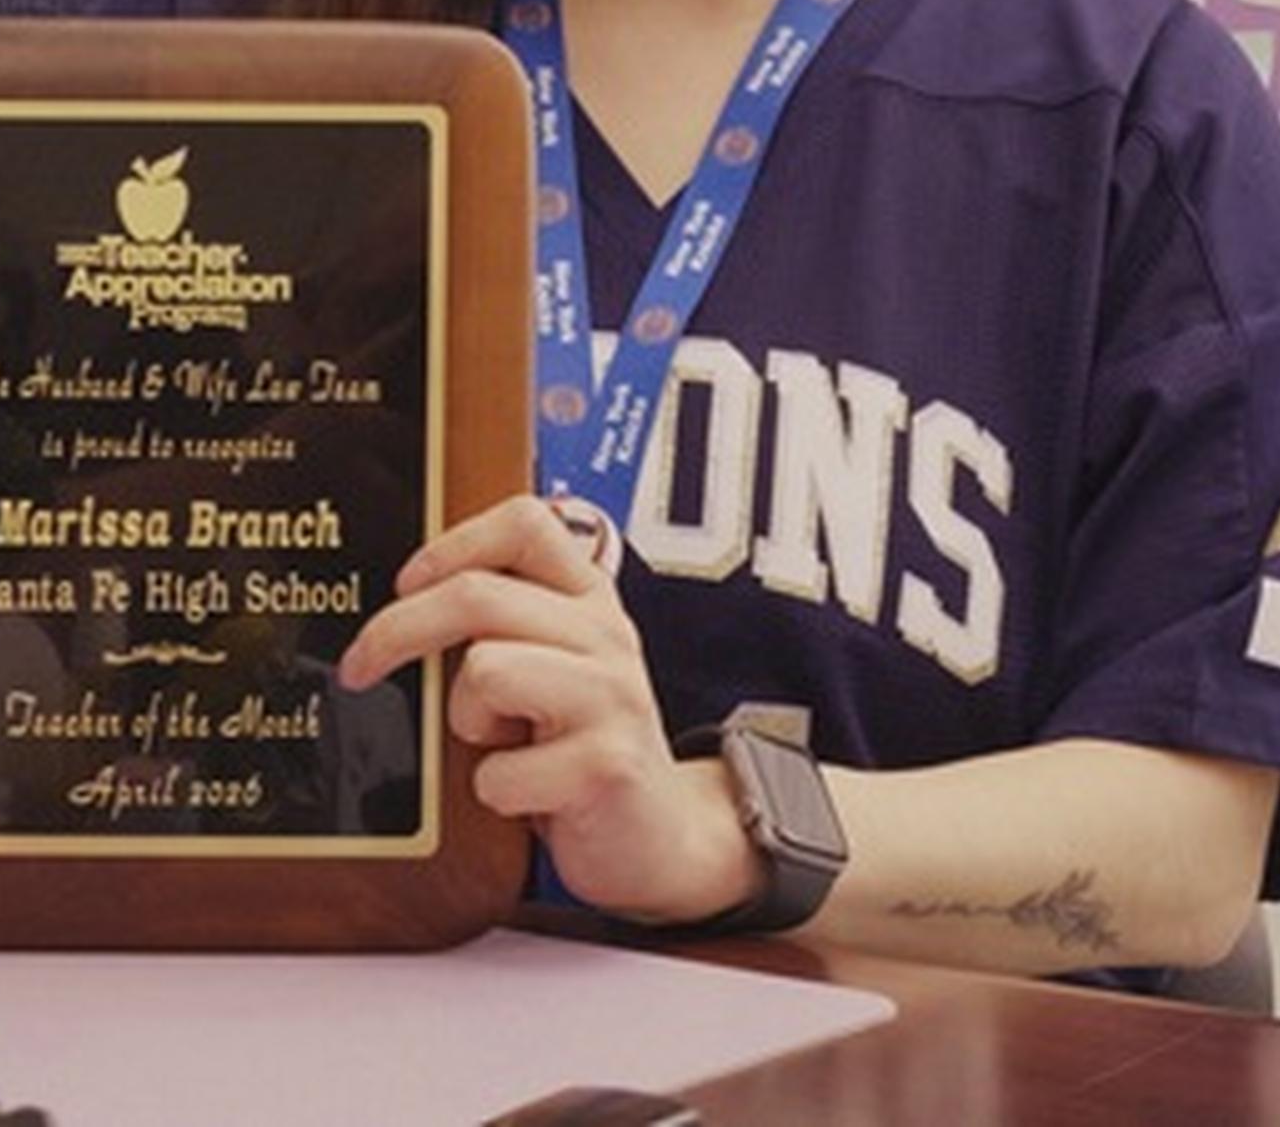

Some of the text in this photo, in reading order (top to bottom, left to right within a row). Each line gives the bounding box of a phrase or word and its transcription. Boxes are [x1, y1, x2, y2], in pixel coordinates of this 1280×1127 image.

[64, 267, 292, 306] Appreciation
[129, 304, 248, 333] Program
[17, 354, 133, 400] Husband
[141, 363, 165, 400] &
[173, 361, 237, 414] Wife
[246, 361, 301, 402] Law
[310, 361, 381, 402] Team
[42, 420, 297, 474] is proud to recognize
[186, 499, 342, 549] Branch
[92, 570, 131, 613] Fe
[146, 571, 230, 624] High
[245, 571, 361, 614] School
[4, 690, 322, 753] Teacher of the Month
[68, 765, 180, 819] April
